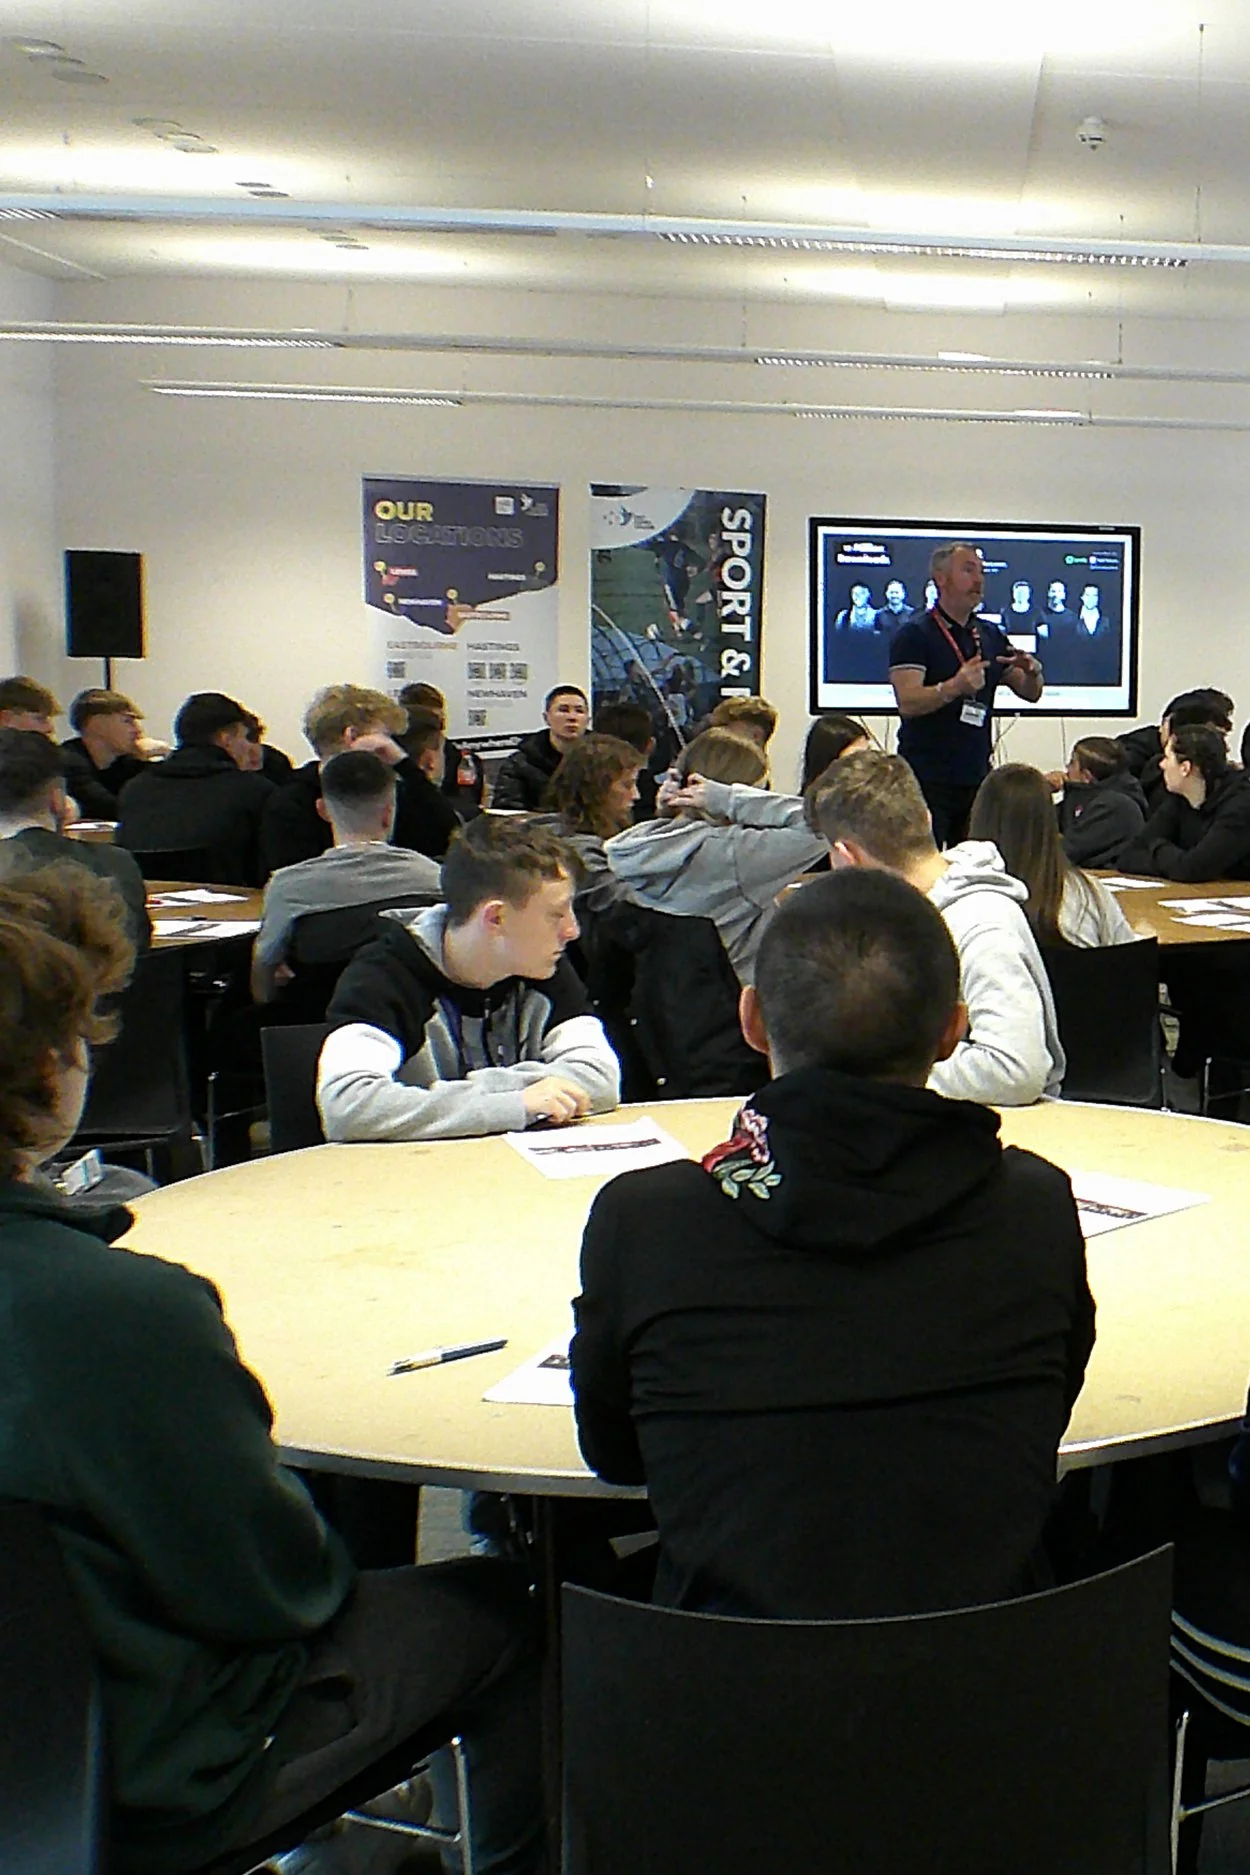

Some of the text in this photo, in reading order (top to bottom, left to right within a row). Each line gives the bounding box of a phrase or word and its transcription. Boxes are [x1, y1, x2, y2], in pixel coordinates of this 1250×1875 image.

[374, 500, 434, 521] OUR
[374, 523, 523, 548] LOCATIONS
[721, 507, 752, 642] SPORT
[466, 642, 520, 651] HASTINGS
[721, 648, 751, 678] &
[466, 690, 527, 698] NEWHAVEN
